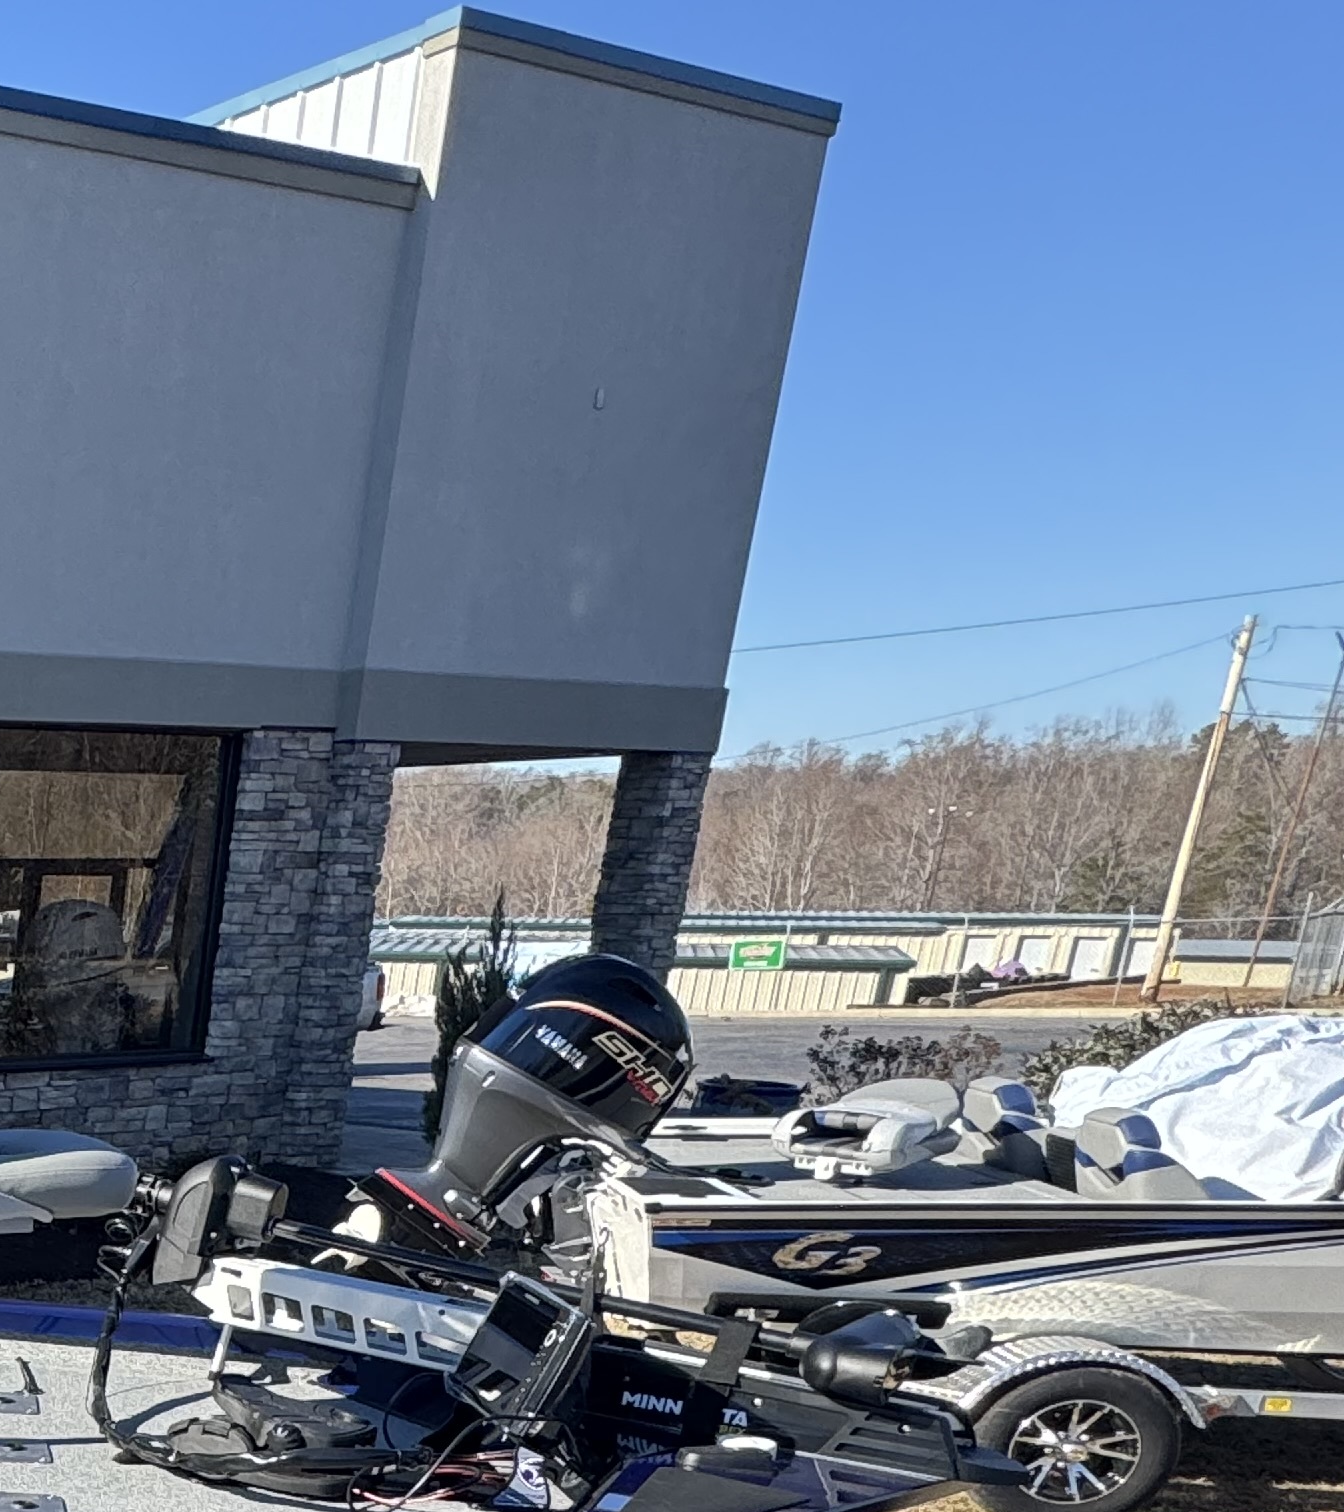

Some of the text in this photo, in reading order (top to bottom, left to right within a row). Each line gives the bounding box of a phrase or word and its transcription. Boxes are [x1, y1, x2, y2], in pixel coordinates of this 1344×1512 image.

[535, 1024, 588, 1070] YAMAHA
[592, 1031, 673, 1104] SHO
[772, 1231, 882, 1276] G3
[621, 1391, 748, 1428] MINN TA
